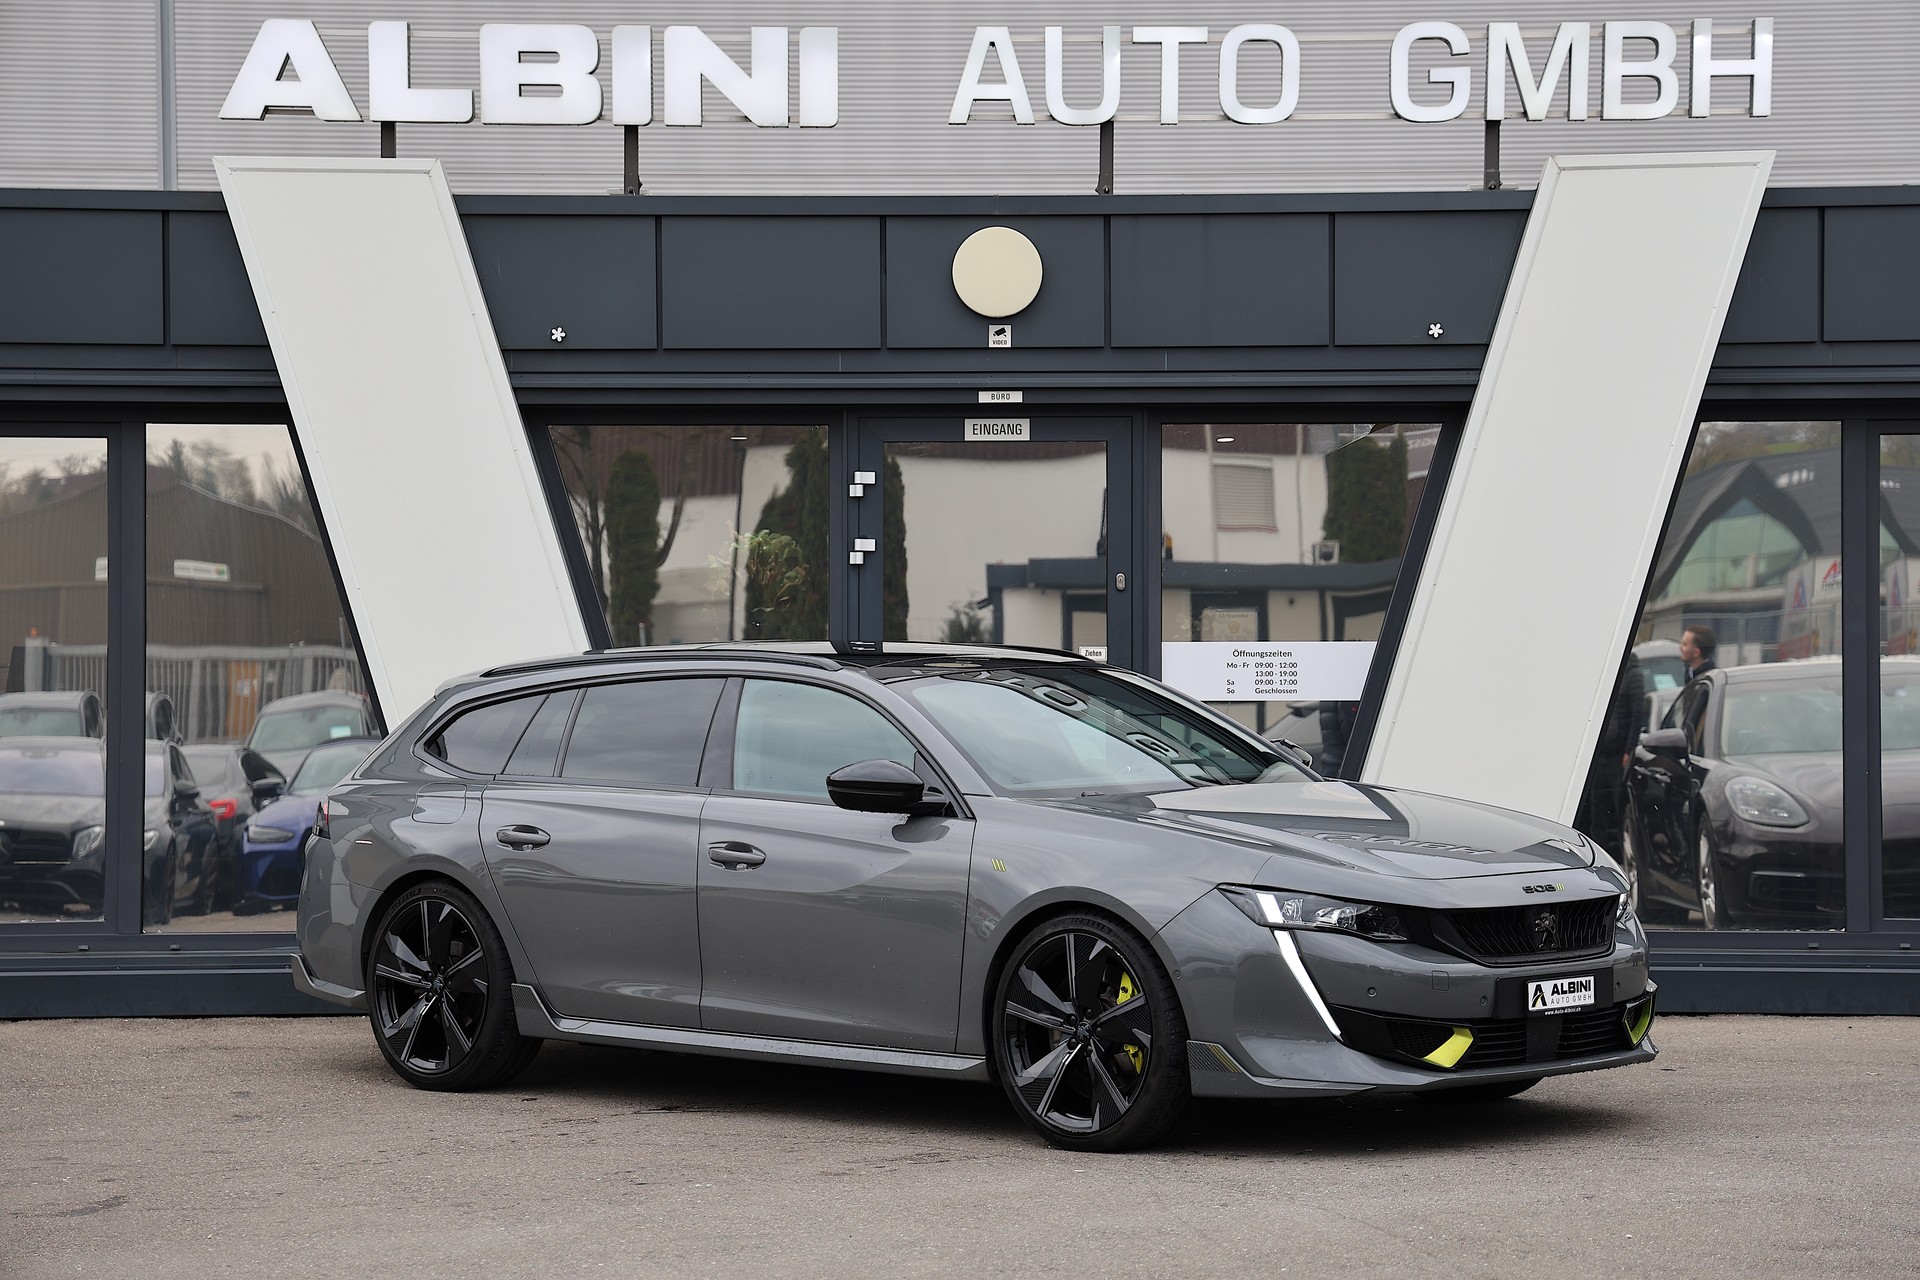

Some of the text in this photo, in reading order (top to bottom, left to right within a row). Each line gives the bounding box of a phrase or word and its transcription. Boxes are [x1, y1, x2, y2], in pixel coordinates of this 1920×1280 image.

[218, 16, 1774, 127] ALBINI AUTO GMBH
[990, 392, 1011, 401] BÜRO
[972, 423, 1023, 436] EINGANG
[1084, 649, 1102, 657] Ziehen
[1232, 649, 1292, 658] Öffnungszeiten
[1064, 917, 1112, 935] MICHELIN
[1551, 980, 1591, 996] ALBINI
[1550, 994, 1592, 1005] AUTO GMBH
